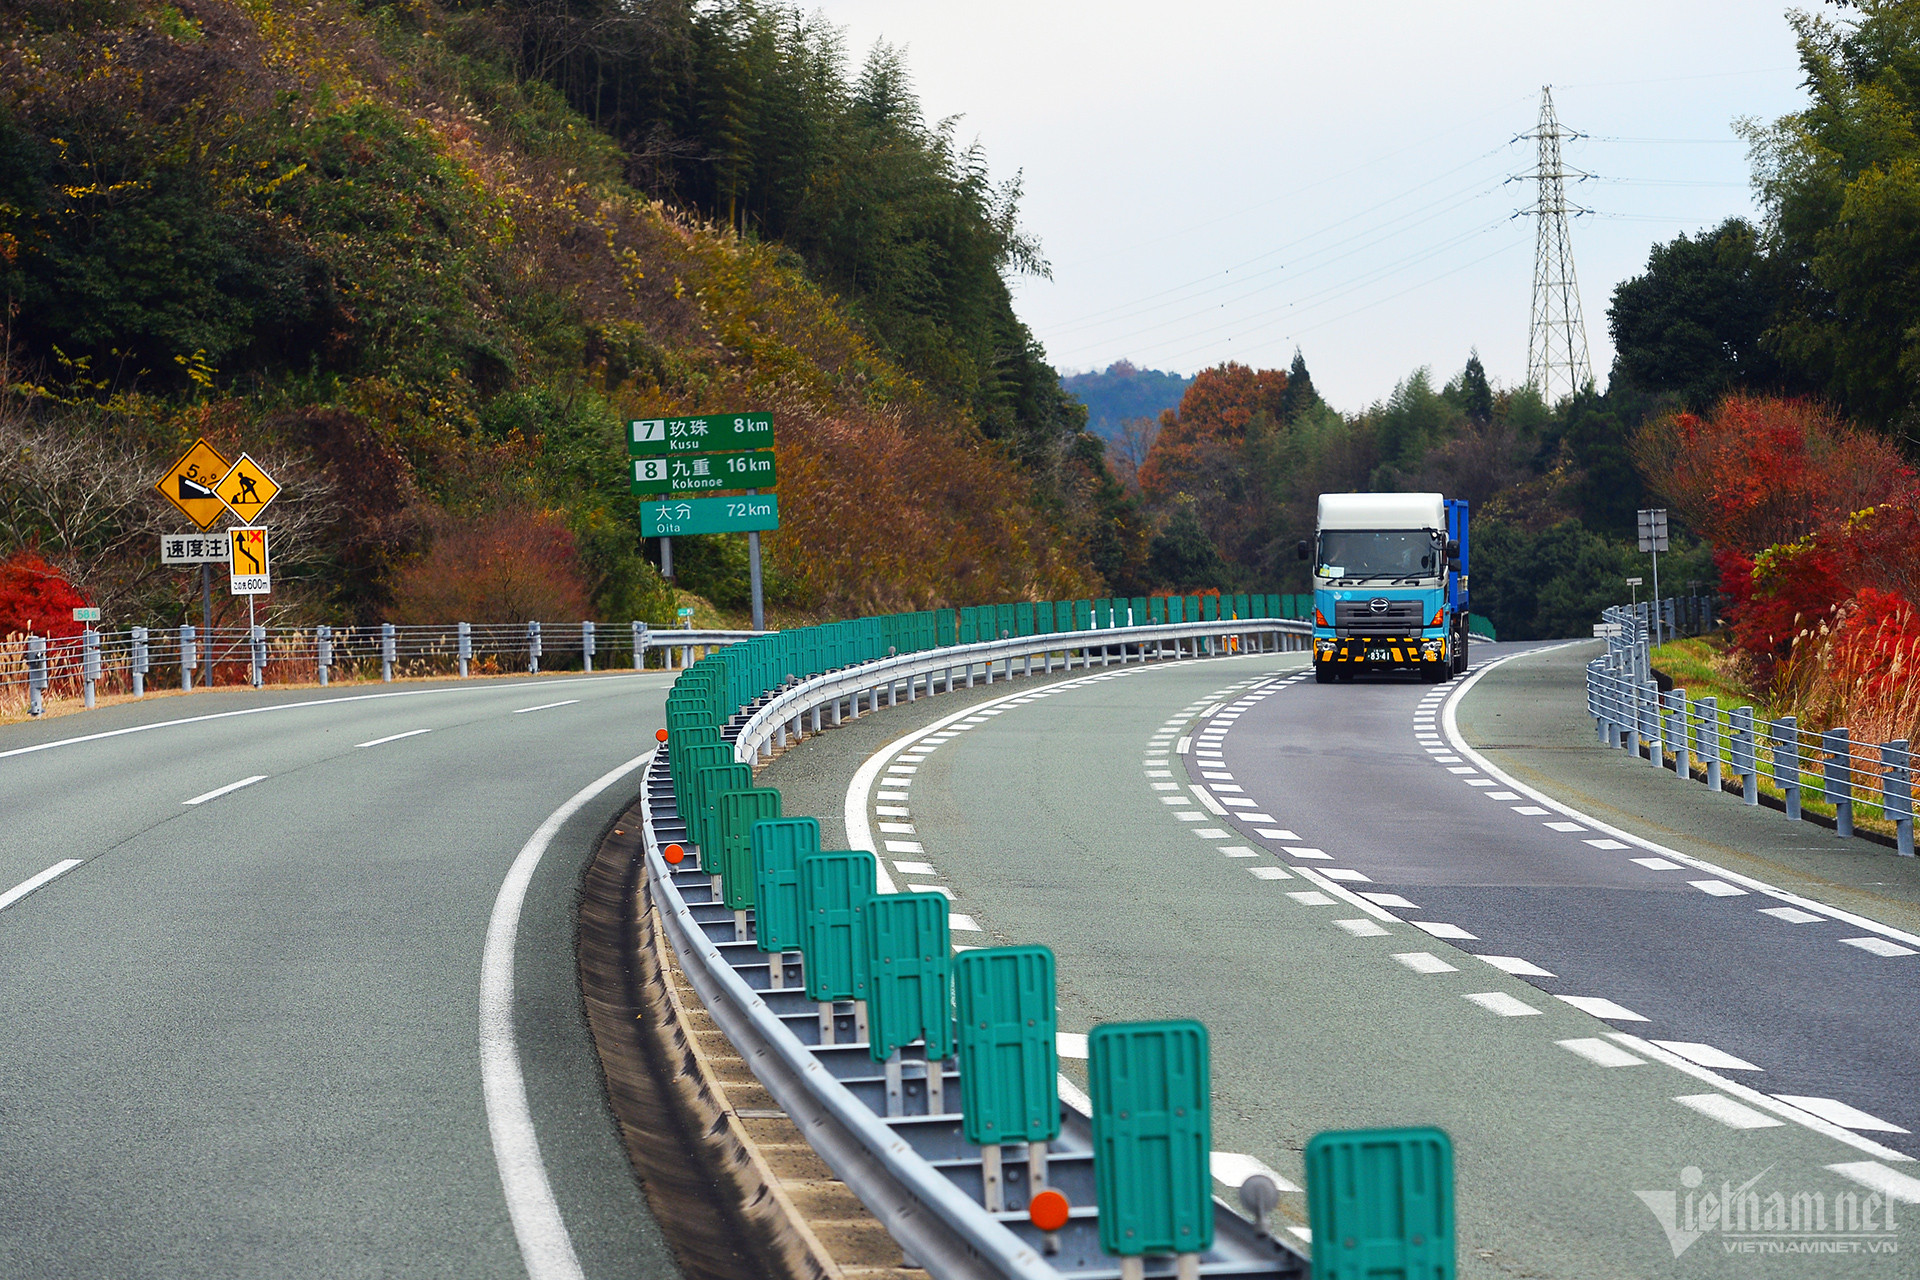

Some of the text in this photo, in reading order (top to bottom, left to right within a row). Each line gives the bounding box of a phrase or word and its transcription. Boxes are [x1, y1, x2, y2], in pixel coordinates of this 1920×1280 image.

[642, 422, 655, 440] 7
[669, 420, 709, 438] 玖珠
[670, 440, 699, 450] Kusu
[644, 461, 658, 479] 8
[672, 458, 711, 477] 九重
[672, 478, 723, 490] Kokonoe
[655, 503, 692, 521] 大分
[656, 523, 681, 533] Oita
[166, 539, 230, 558] 速度注
